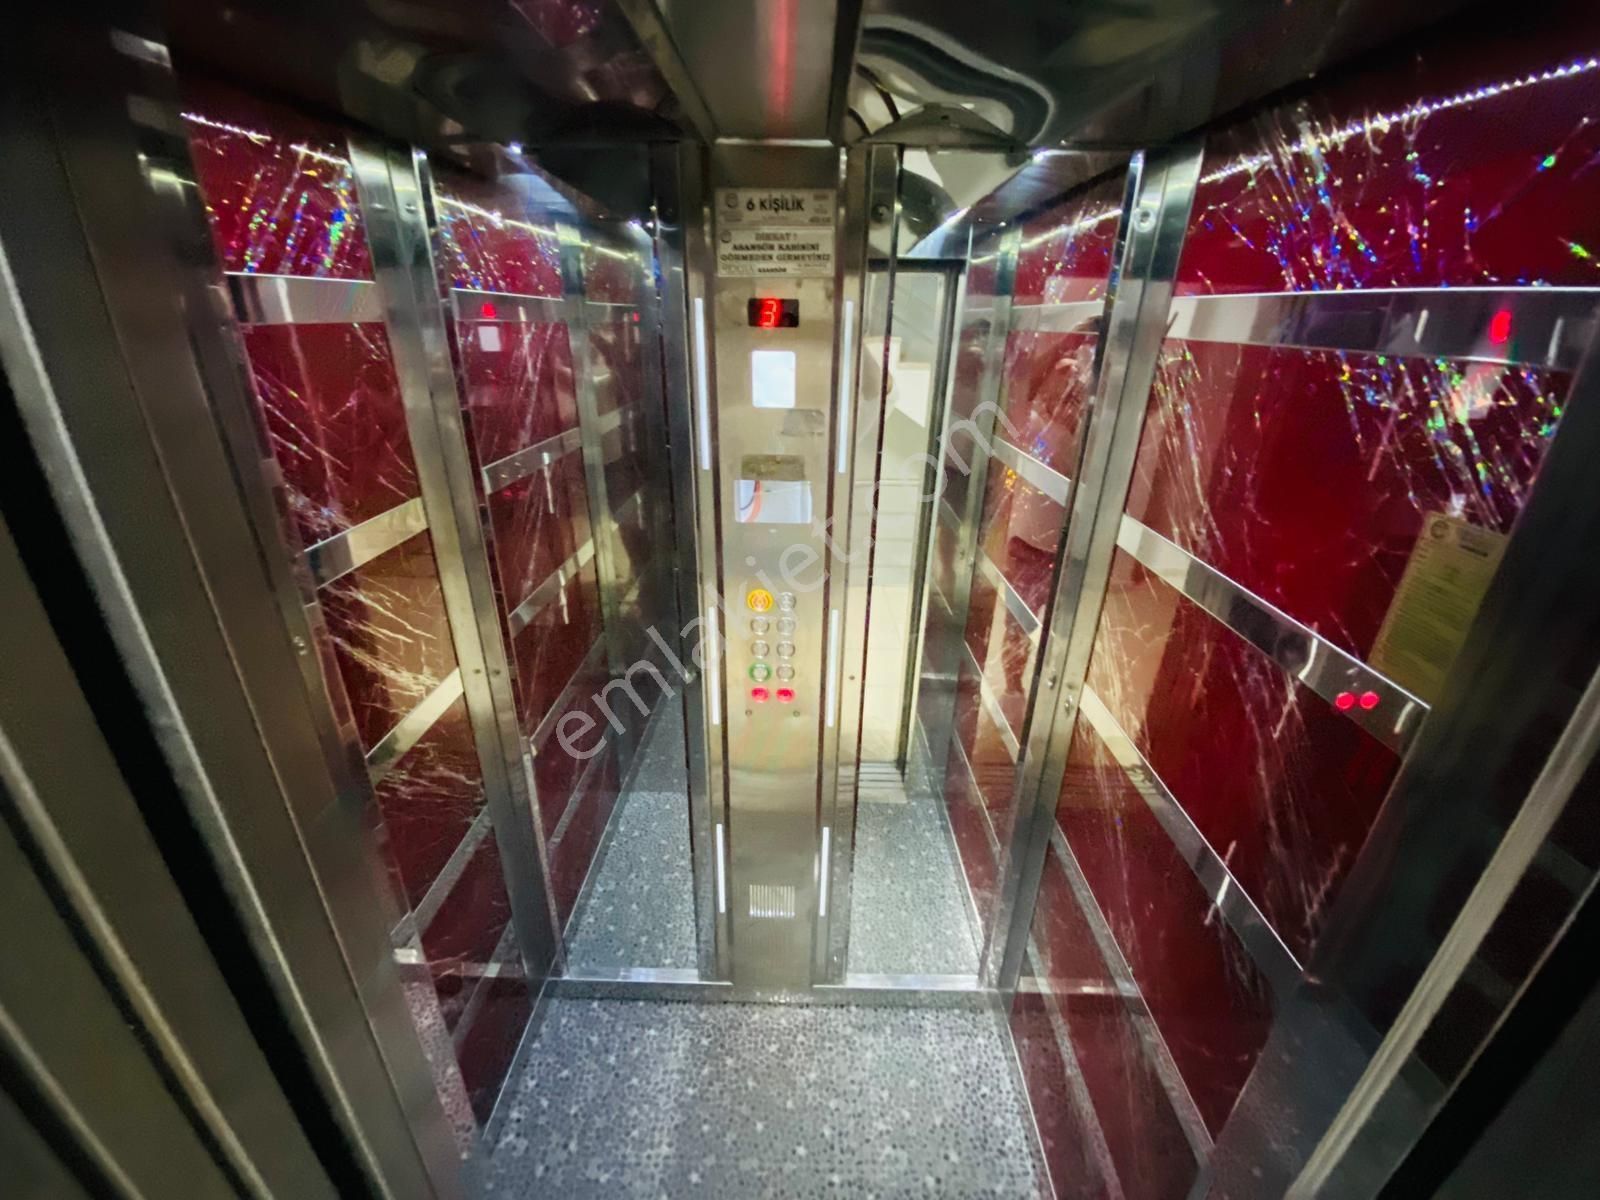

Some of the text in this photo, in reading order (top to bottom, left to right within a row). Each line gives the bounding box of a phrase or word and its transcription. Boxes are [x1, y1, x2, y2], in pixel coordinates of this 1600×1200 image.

[746, 197, 755, 211] 6
[759, 193, 805, 213] KİŞİLİK
[760, 300, 777, 327] 3
